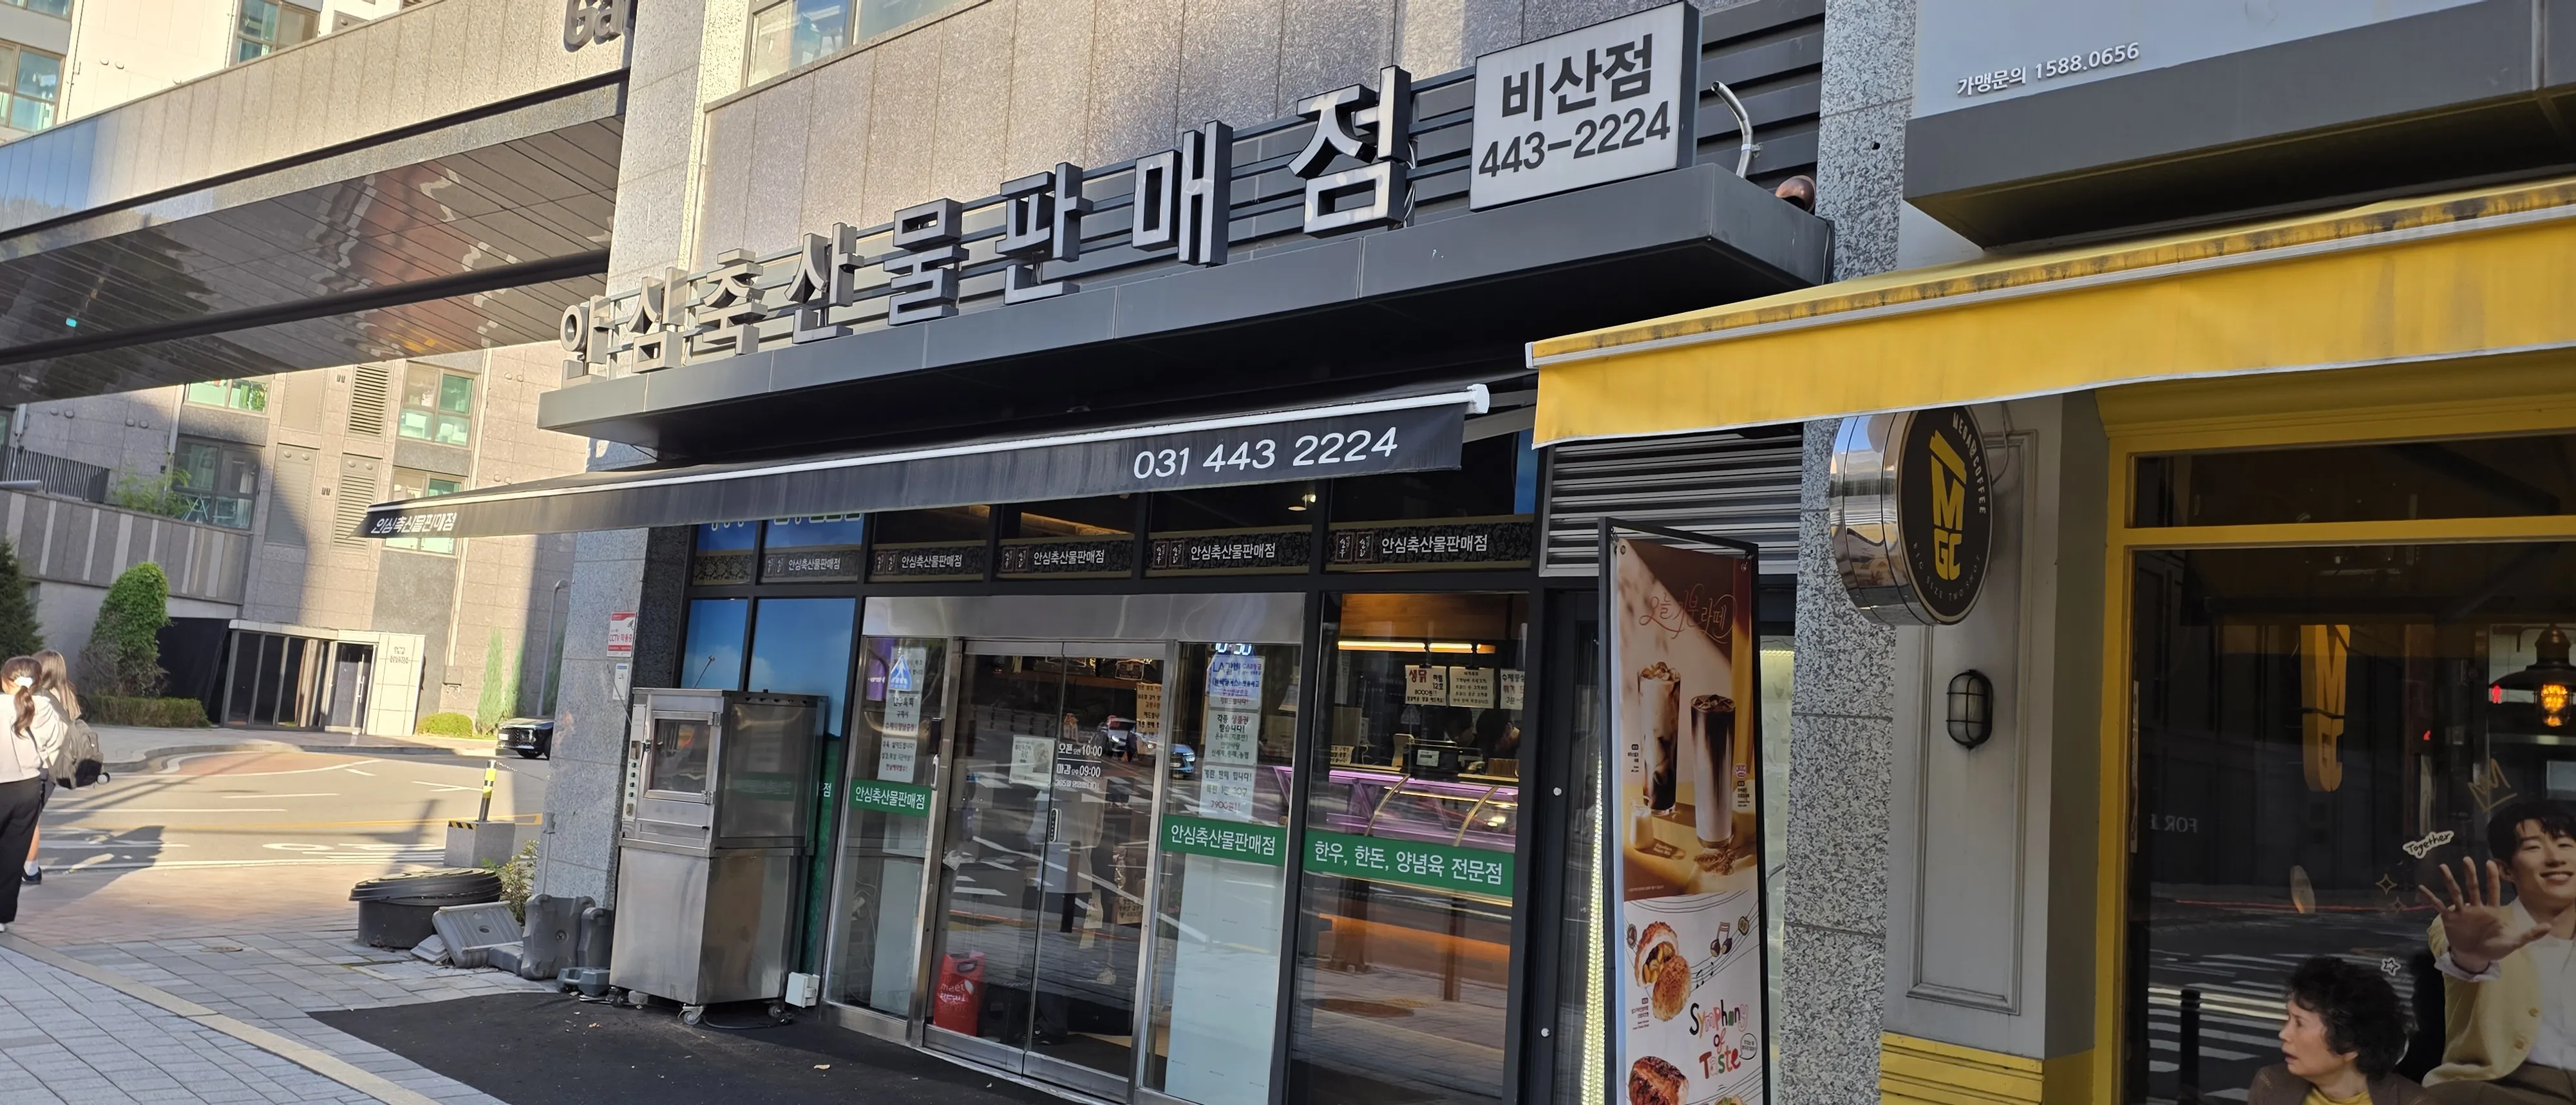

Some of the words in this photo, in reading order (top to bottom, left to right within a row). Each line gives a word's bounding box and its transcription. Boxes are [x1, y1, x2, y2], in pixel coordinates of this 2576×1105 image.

[1501, 33, 1653, 121] 비산점
[1957, 66, 2027, 95] 가맹문의
[2035, 41, 2140, 79] 1588.0656
[1478, 100, 1671, 178] 443-2224
[560, 65, 1412, 388] 안심축산물판매점
[1133, 448, 1189, 479] 031
[1202, 439, 1276, 472] 443
[1293, 426, 1398, 467] 2224
[1973, 456, 1986, 515] COFFEE
[1190, 542, 1276, 561] 안심축산물판매점
[1381, 534, 1488, 554] 안심축산물판매점
[788, 556, 840, 571] 안심축산물판매점
[902, 554, 963, 569] 안심축산물판매점
[1033, 549, 1104, 566] 안심축산물판매점
[1409, 670, 1427, 683] 생닭
[1231, 715, 1249, 725] 상품권
[1058, 743, 1073, 755] 오픈
[1082, 744, 1103, 757] 10:00
[1056, 764, 1071, 775] 마감
[1079, 765, 1101, 778] 09:00
[855, 786, 926, 810] 안심축산물판매점
[1171, 824, 1276, 856] 안심축산물판매점
[2405, 833, 2451, 856] Together
[1314, 840, 1348, 866] 한우,
[1354, 845, 1389, 873] 한돈,
[1396, 851, 1444, 878] 양념육
[1451, 857, 1502, 885] 전문점
[1689, 999, 1749, 1039] Symphony
[1713, 1028, 1726, 1053] of
[1698, 1048, 1741, 1079] Taste
